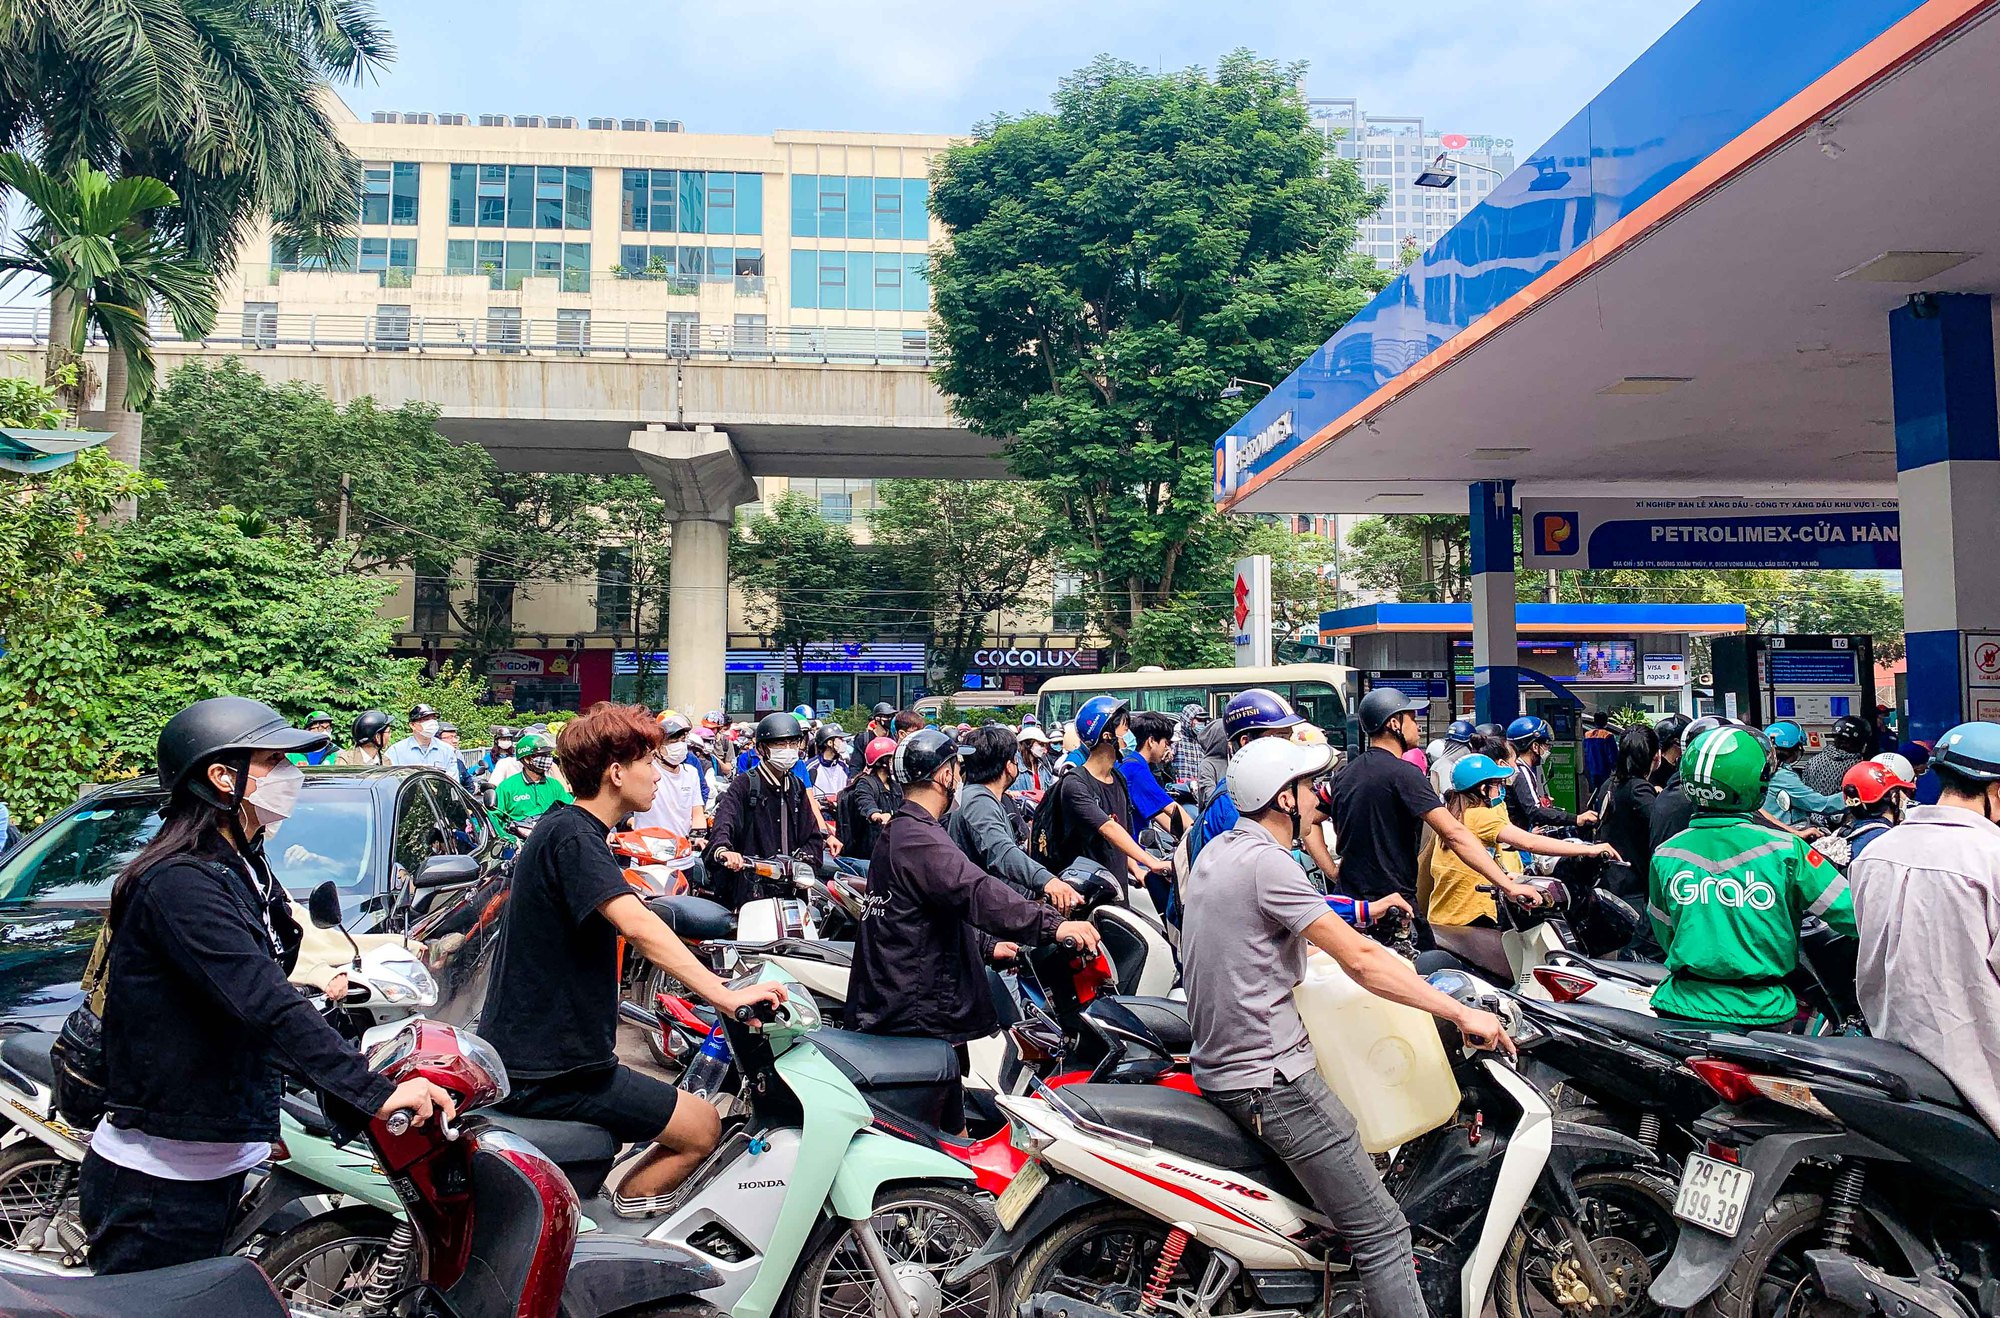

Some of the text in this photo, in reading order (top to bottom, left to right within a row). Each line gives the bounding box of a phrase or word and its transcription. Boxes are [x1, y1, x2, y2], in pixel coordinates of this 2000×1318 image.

[1651, 521, 1845, 541] PETROLIMEX-CỬA
[1835, 639, 1846, 647] 16
[974, 649, 1081, 667] COCOLUX
[514, 793, 530, 801] Grab
[1686, 781, 1726, 801] Grab
[1670, 870, 1776, 910] Grab
[1156, 1162, 1224, 1186] SIRIUS
[1690, 1160, 1741, 1199] 29-C1
[737, 1179, 786, 1190] HONDA
[1680, 1187, 1739, 1230] 199.38
